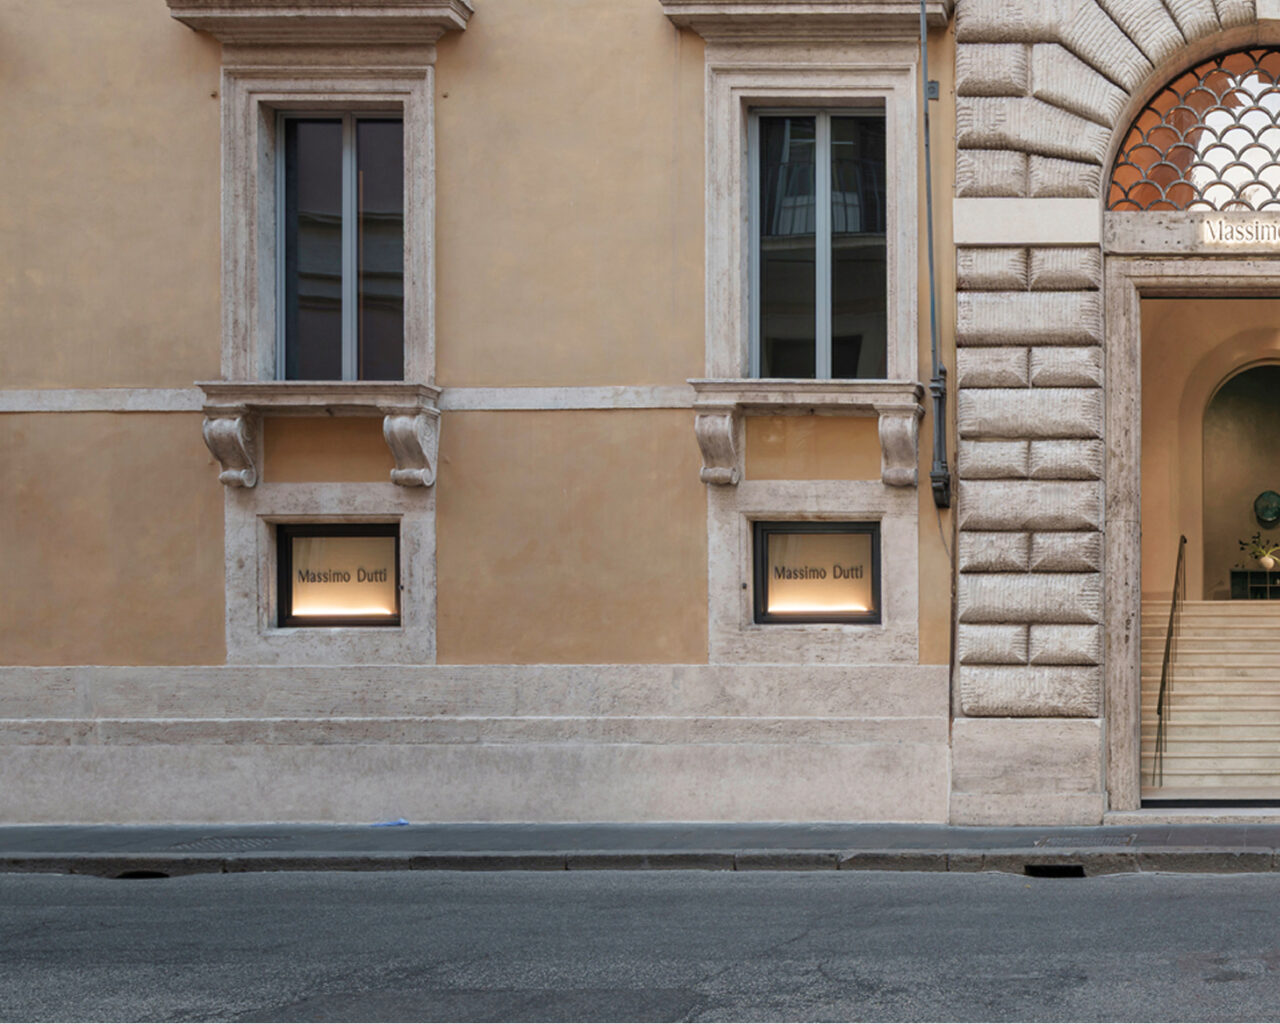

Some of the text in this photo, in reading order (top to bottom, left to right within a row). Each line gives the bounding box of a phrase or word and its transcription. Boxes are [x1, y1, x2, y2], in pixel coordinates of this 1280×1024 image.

[298, 568, 387, 583] Massimo Dutti
[774, 564, 863, 579] Massimo Dutti
